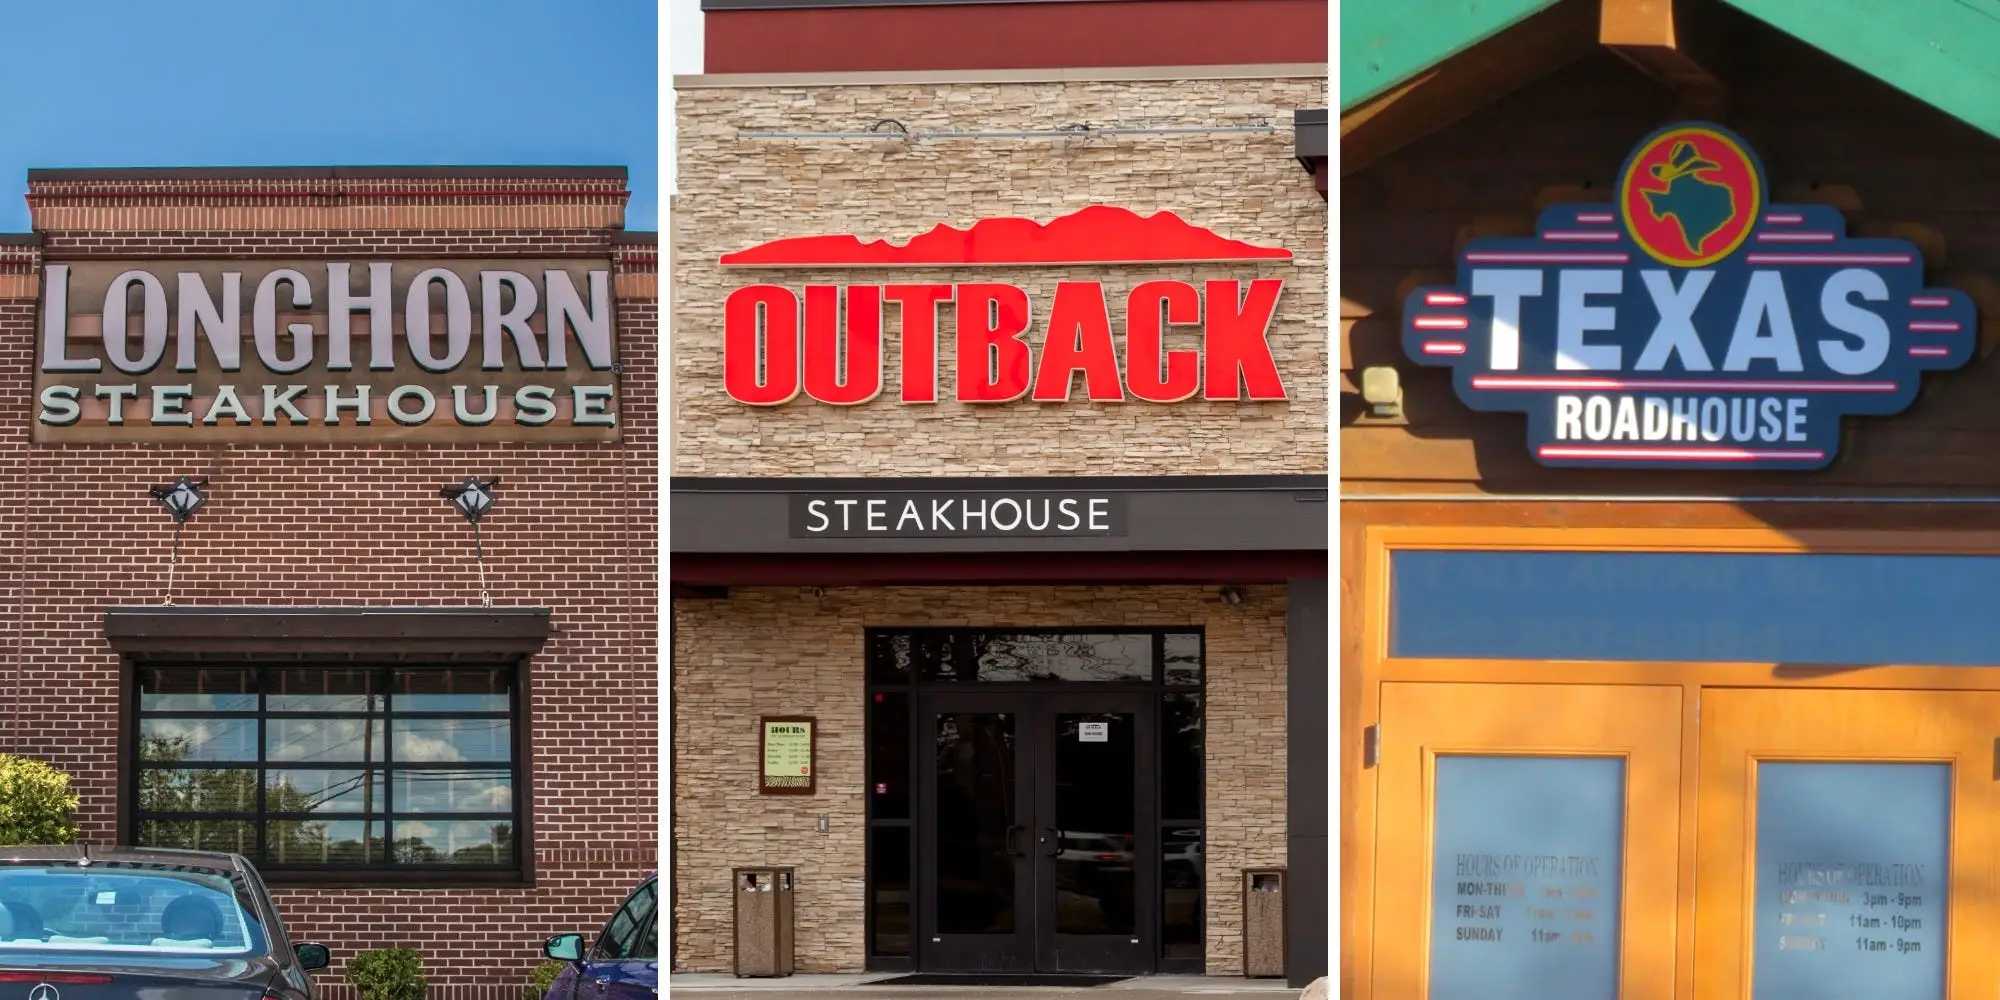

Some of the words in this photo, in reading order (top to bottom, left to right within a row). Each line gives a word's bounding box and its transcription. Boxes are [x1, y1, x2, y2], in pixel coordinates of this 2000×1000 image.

[41, 261, 612, 374] LONGHORN
[1472, 268, 1890, 375] TEXAS
[724, 279, 1289, 406] OUTBACK
[39, 383, 616, 428] STEAKHOUSE
[1556, 396, 1808, 442] ROADHOUSE
[806, 497, 1111, 532] STEAKHOUSE
[1456, 853, 1500, 877] HOURS
[1524, 854, 1599, 878] OPERATION
[1863, 892, 1888, 910] 3pm
[1898, 892, 1922, 909] 9pm
[1456, 926, 1503, 942] SUNDAY
[1850, 914, 1880, 929] 11am
[1891, 914, 1921, 932] 10pm
[1856, 937, 1886, 951] 11am
[1896, 937, 1921, 954] 9pm
